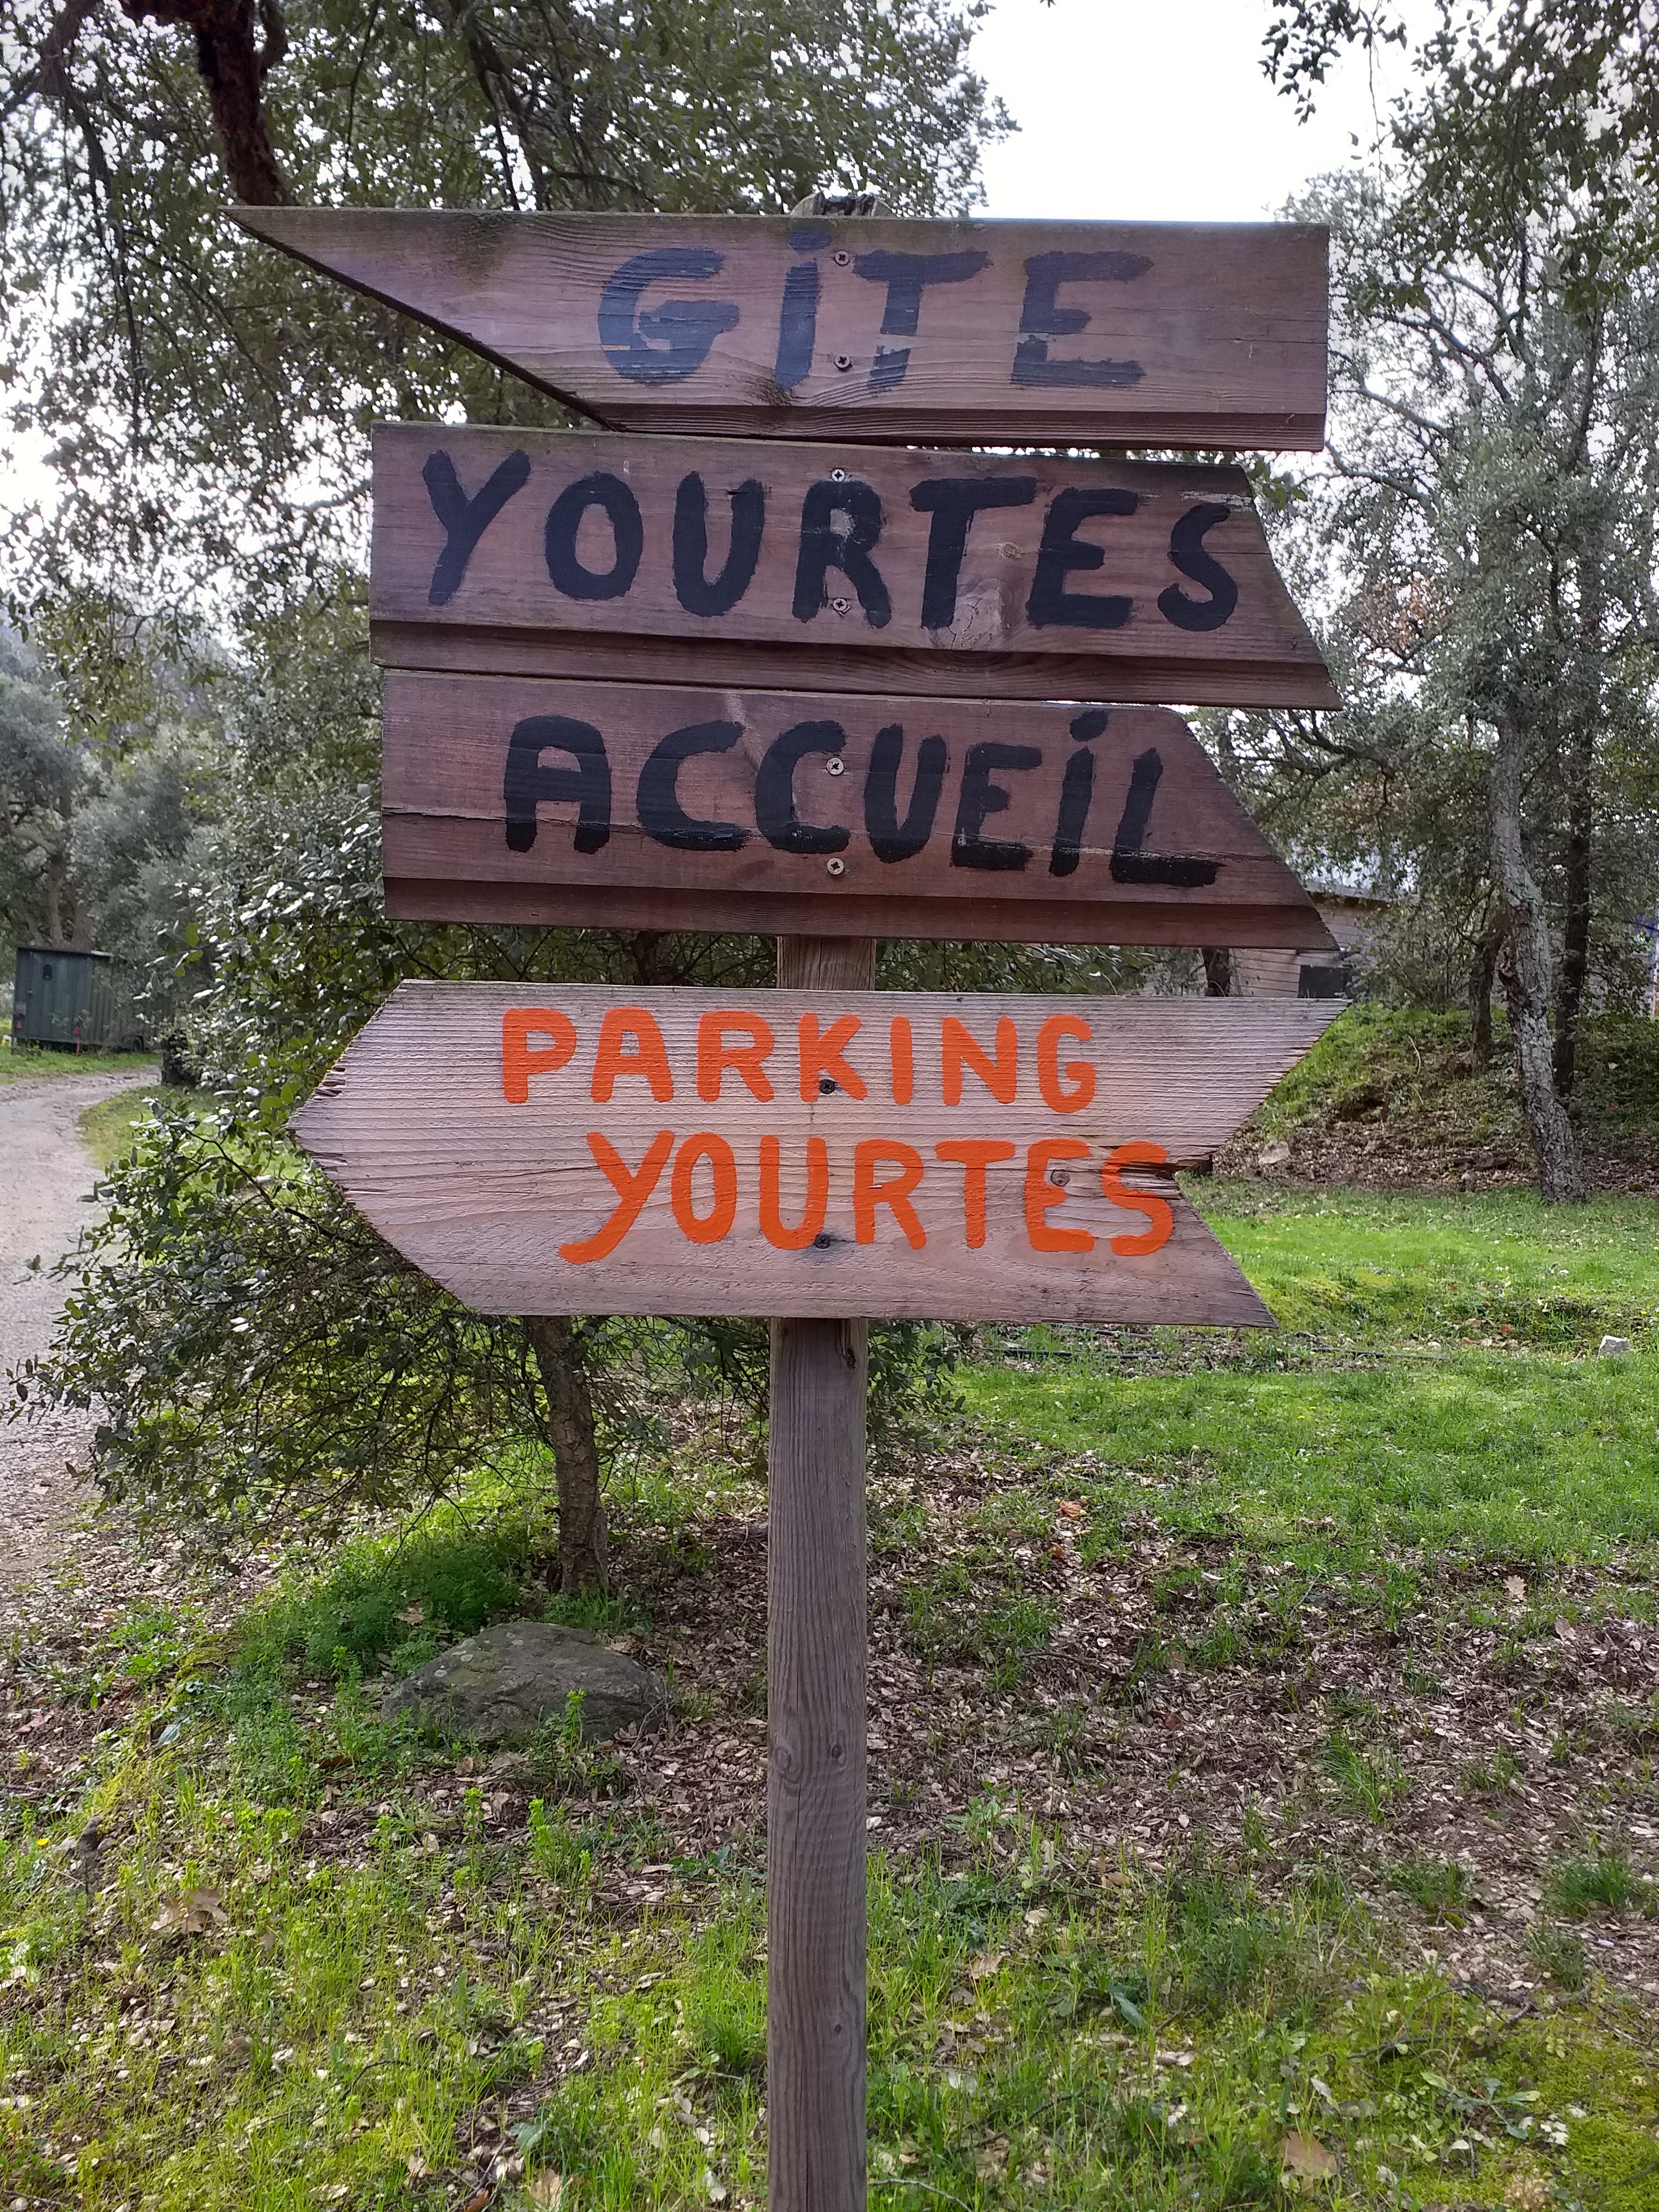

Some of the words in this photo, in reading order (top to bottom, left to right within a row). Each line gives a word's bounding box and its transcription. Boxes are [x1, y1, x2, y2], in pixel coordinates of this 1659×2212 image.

[422, 450, 1238, 631] YOURTES
[500, 1005, 1096, 1113] PARKING
[559, 1130, 1174, 1265] YOURTES
